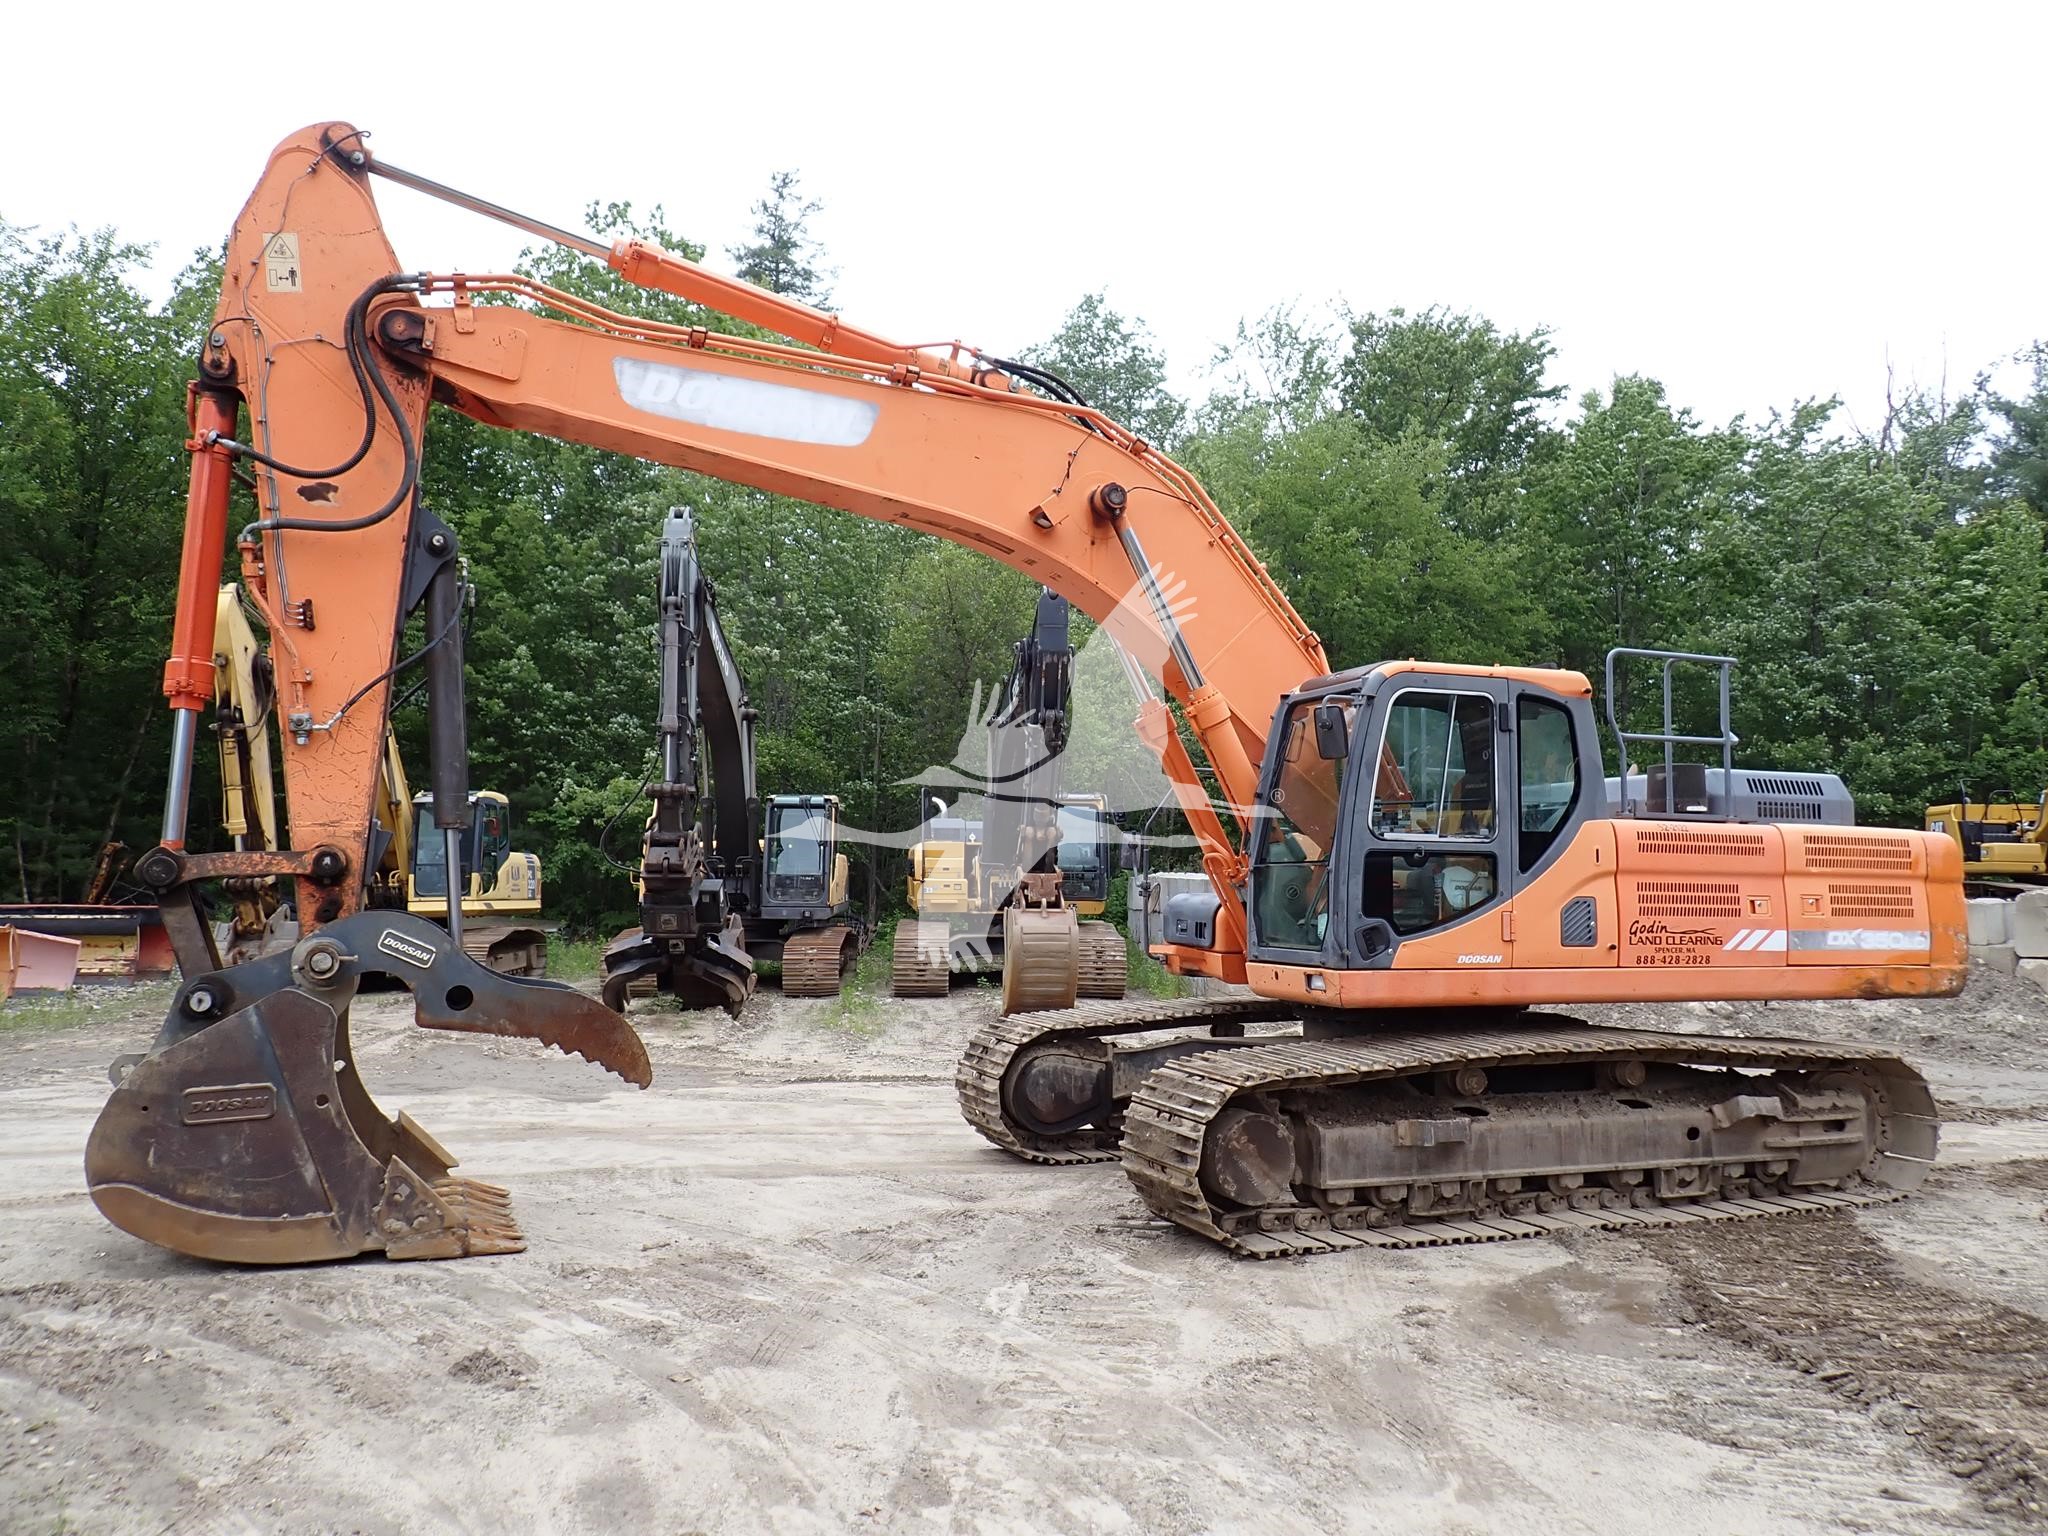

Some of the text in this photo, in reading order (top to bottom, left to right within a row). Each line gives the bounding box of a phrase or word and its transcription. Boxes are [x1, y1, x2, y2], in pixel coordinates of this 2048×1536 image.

[1629, 920, 1668, 936] Godin
[1629, 936, 1723, 946] LAND CLEARING
[383, 937, 431, 960] DOOSAN
[1457, 955, 1502, 964] DOOSAN
[1636, 955, 1711, 965] 888-428-2828
